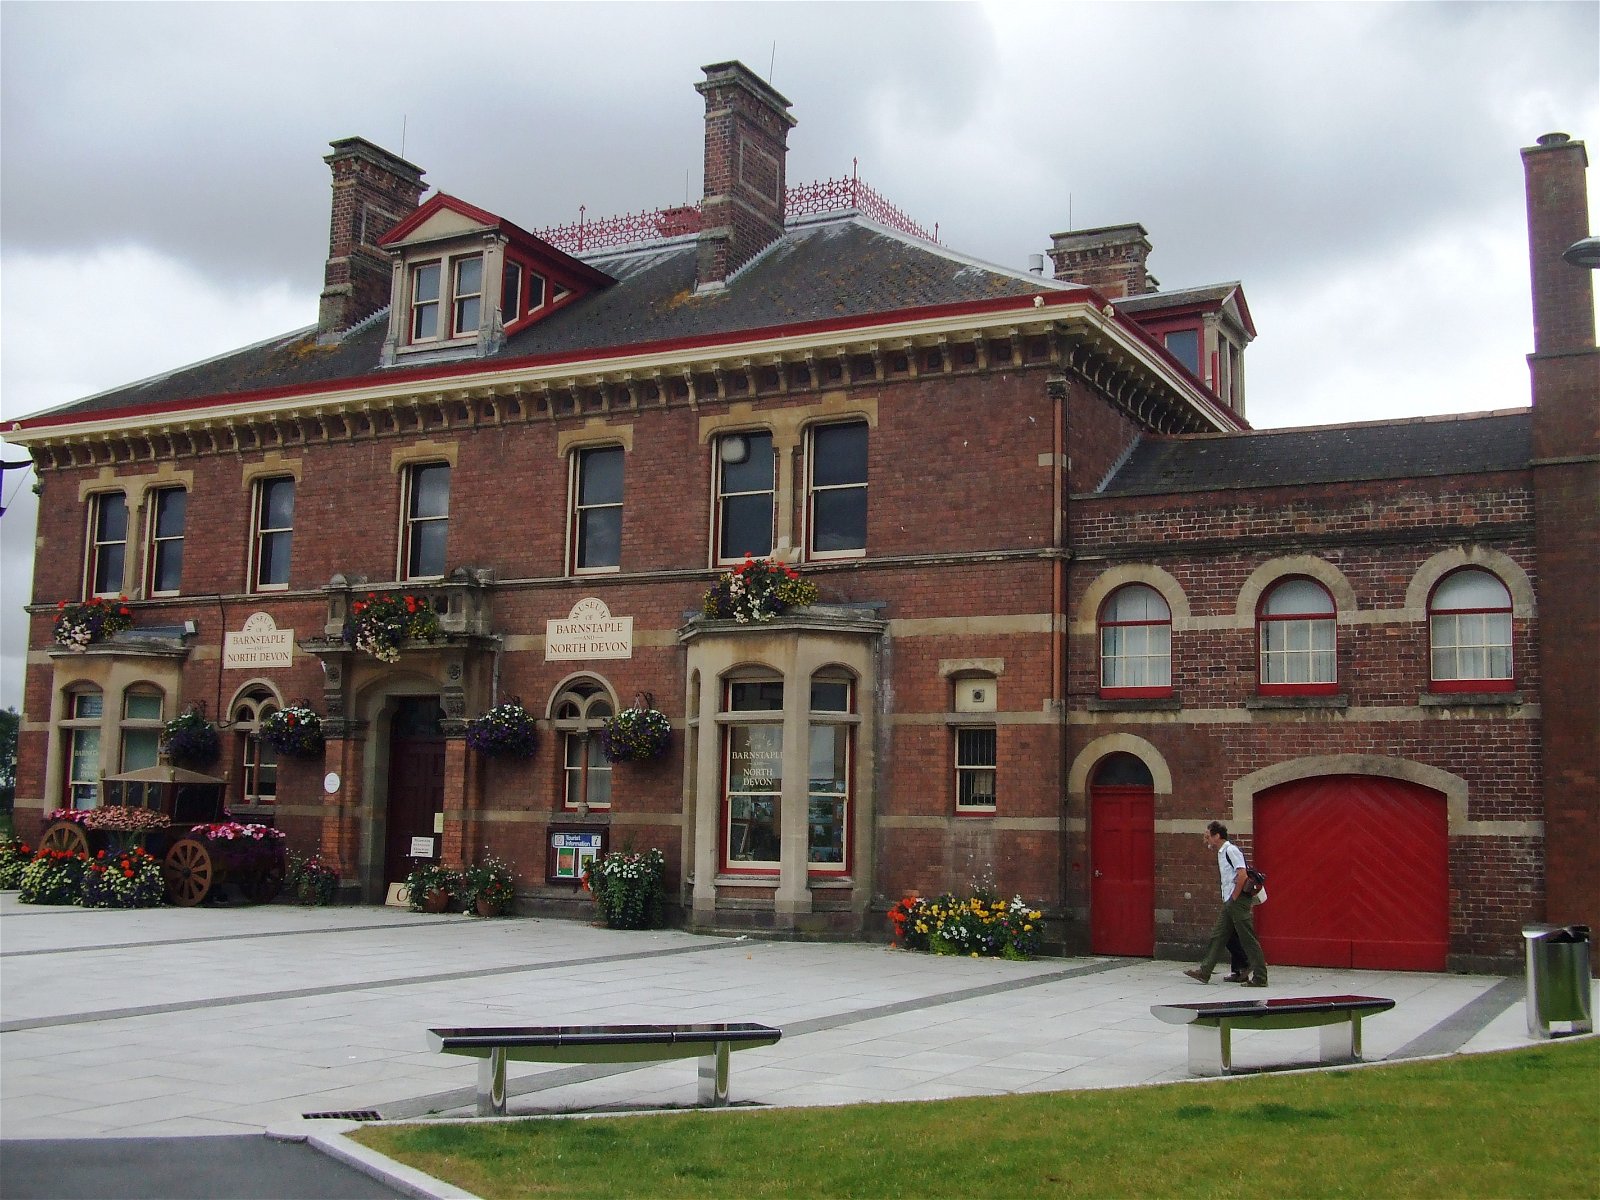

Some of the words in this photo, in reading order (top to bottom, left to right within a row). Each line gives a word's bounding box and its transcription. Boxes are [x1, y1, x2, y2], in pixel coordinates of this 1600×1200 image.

[573, 601, 606, 620] MUSEUM
[556, 622, 623, 634] BARNSTAPLE
[233, 634, 286, 645] BARNSTAPLE
[550, 643, 586, 653] NORTH
[591, 641, 628, 652] DEVON
[228, 653, 257, 662] NORTH
[260, 651, 289, 661] DEVON
[743, 768, 773, 776] NORTH
[743, 778, 773, 786] DEVON
